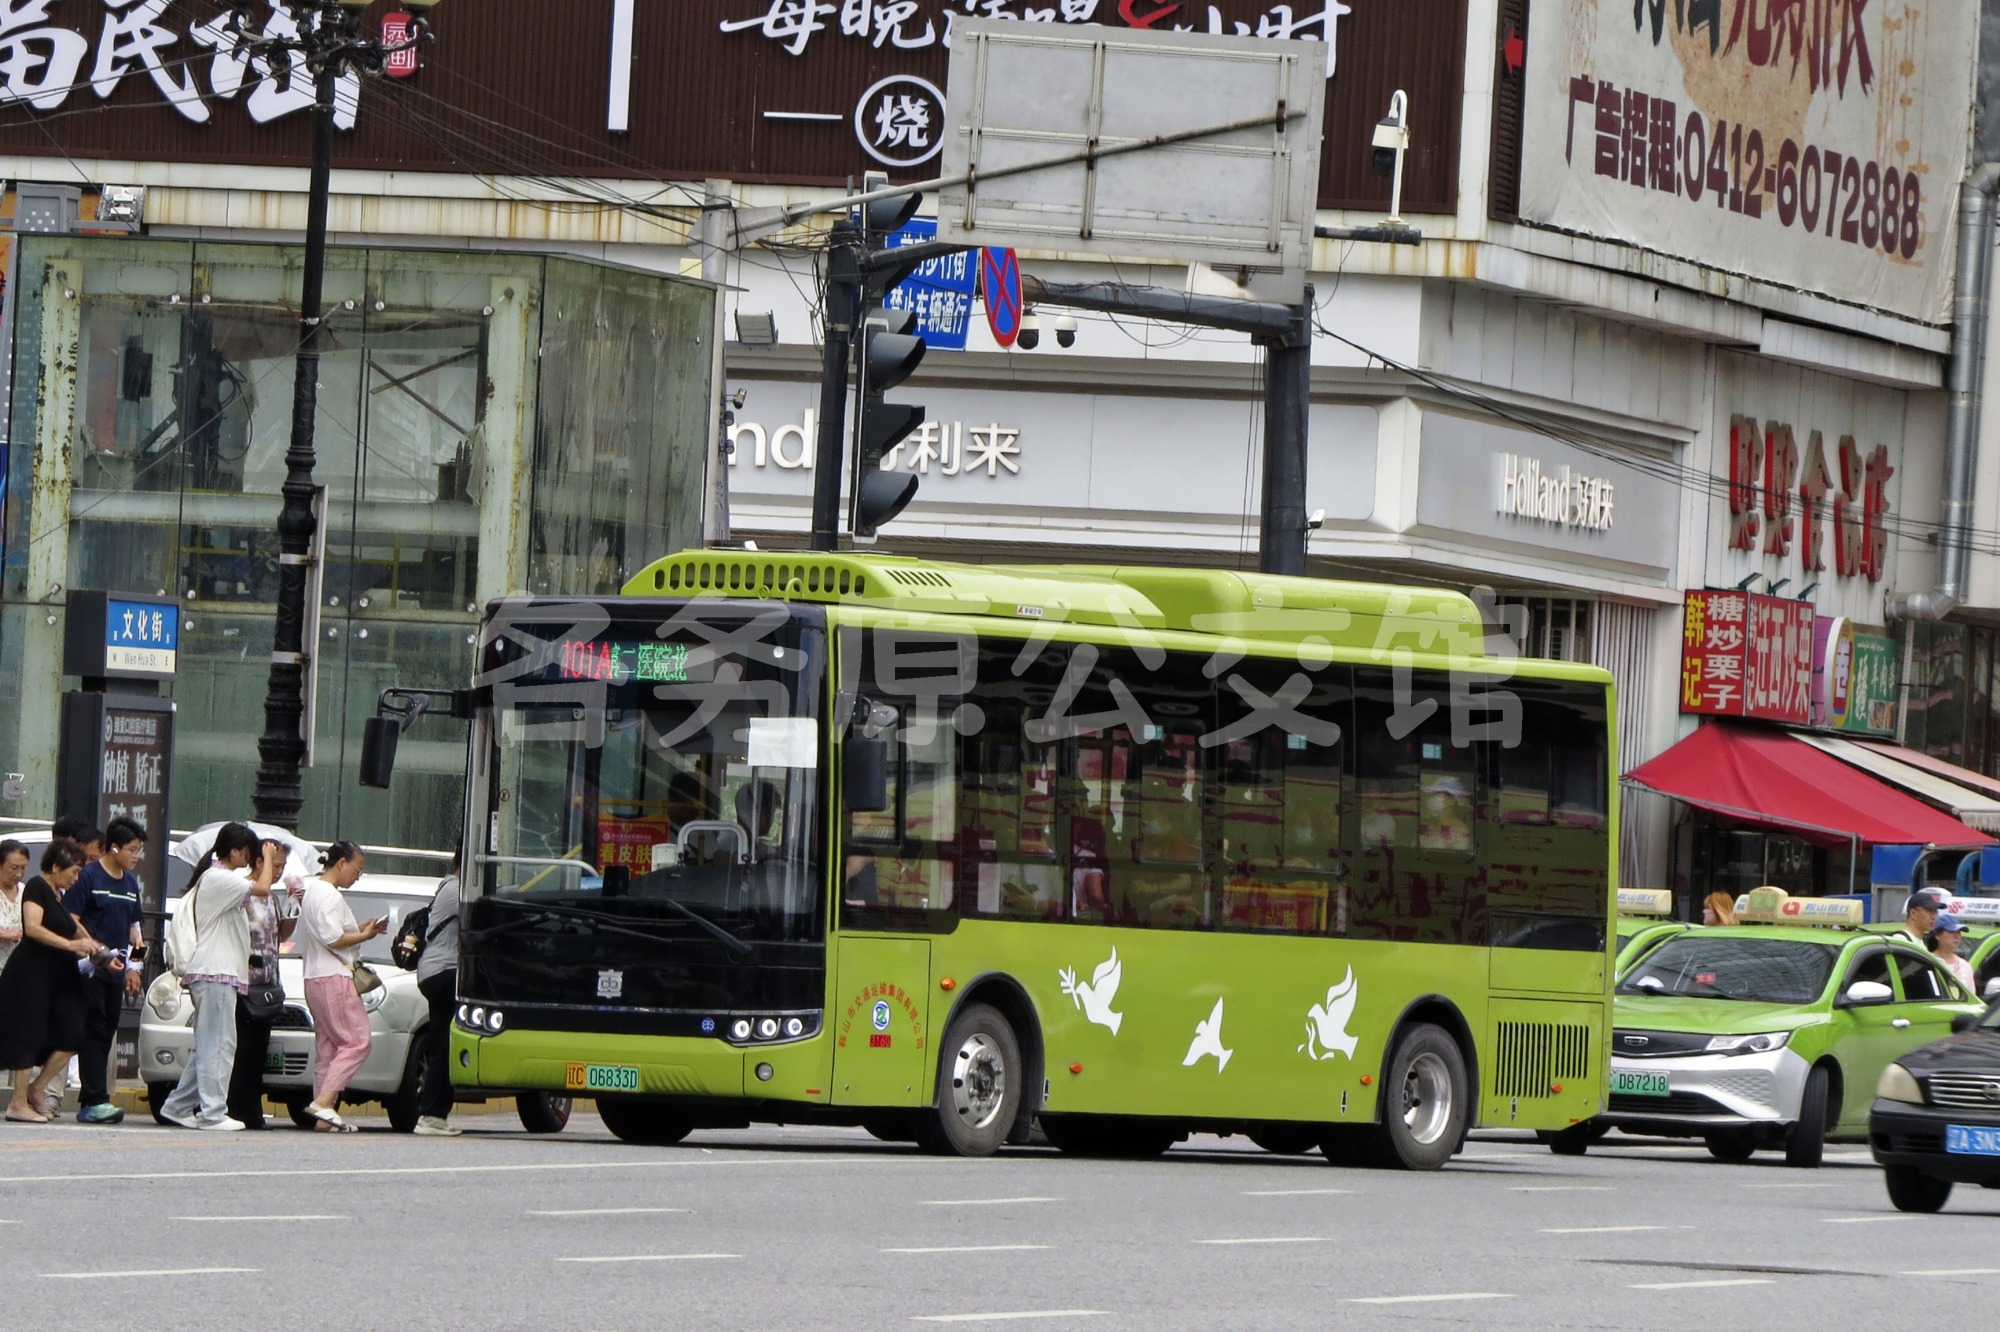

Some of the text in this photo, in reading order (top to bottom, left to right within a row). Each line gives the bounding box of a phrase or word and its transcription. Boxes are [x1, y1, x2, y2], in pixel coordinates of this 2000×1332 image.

[875, 95, 929, 149] 烧
[1567, 73, 1920, 260] 广告招租:0412-6072888
[1501, 452, 1614, 530] Holiland 好利来
[122, 608, 162, 642] 文化街
[1683, 594, 1704, 707] 韩记
[1703, 595, 1746, 710] 糖炒栗子
[563, 641, 612, 679] 101A
[103, 750, 161, 795] 种植 矫正
